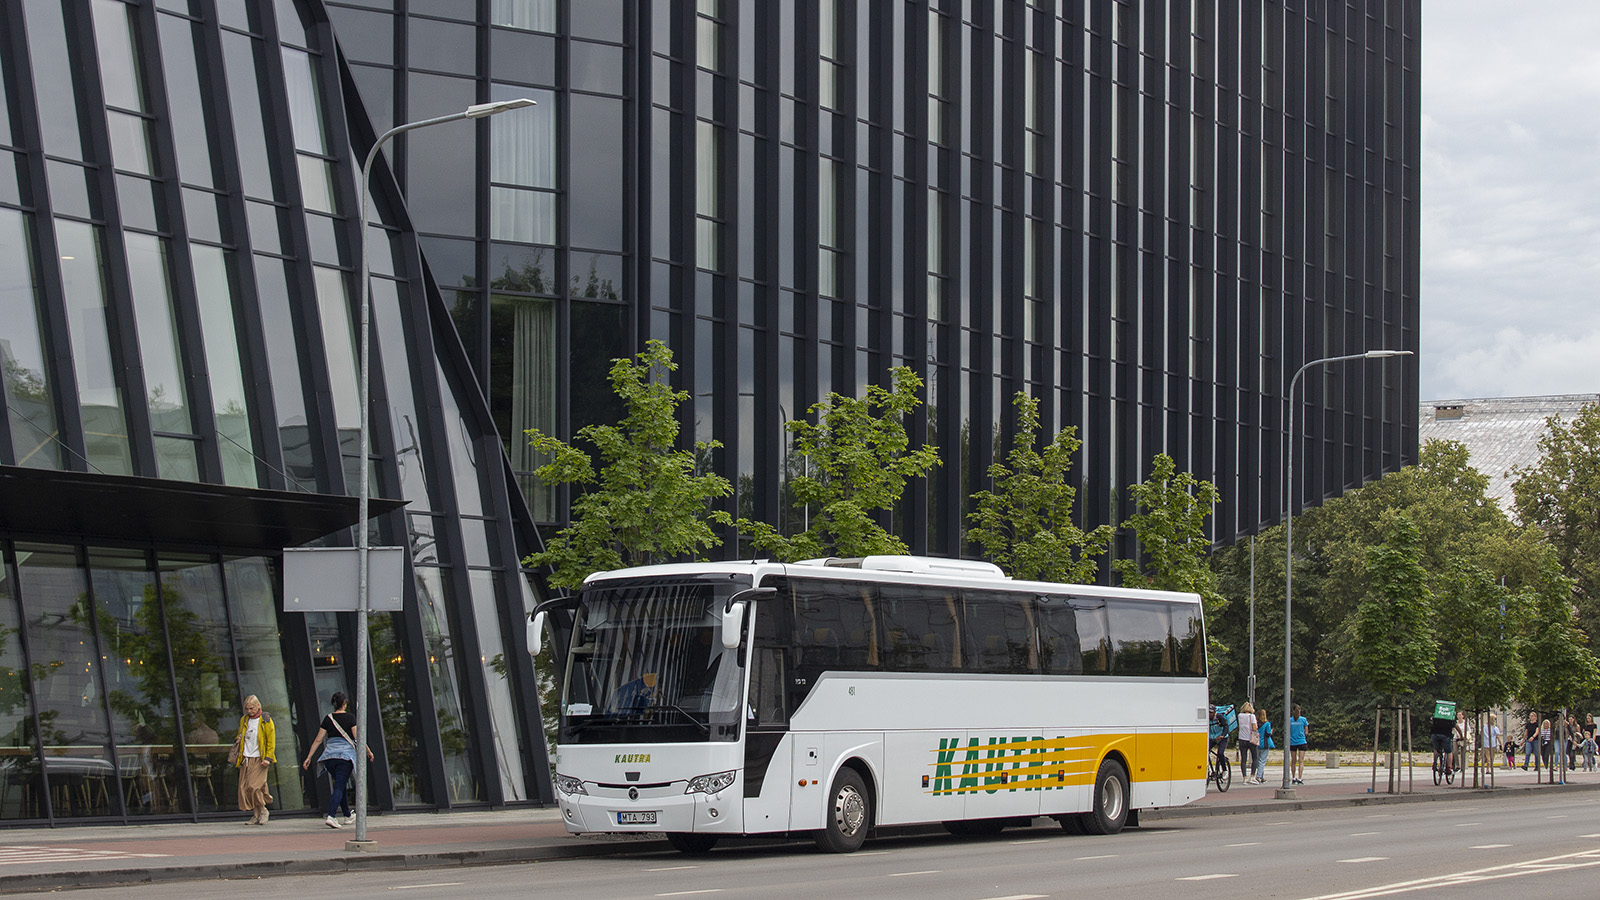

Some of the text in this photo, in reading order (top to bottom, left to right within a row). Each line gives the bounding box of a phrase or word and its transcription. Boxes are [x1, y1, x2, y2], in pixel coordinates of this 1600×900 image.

[614, 753, 651, 764] KAUTRA
[932, 735, 1066, 797] KAUTRA
[622, 813, 655, 822] MTA 793
